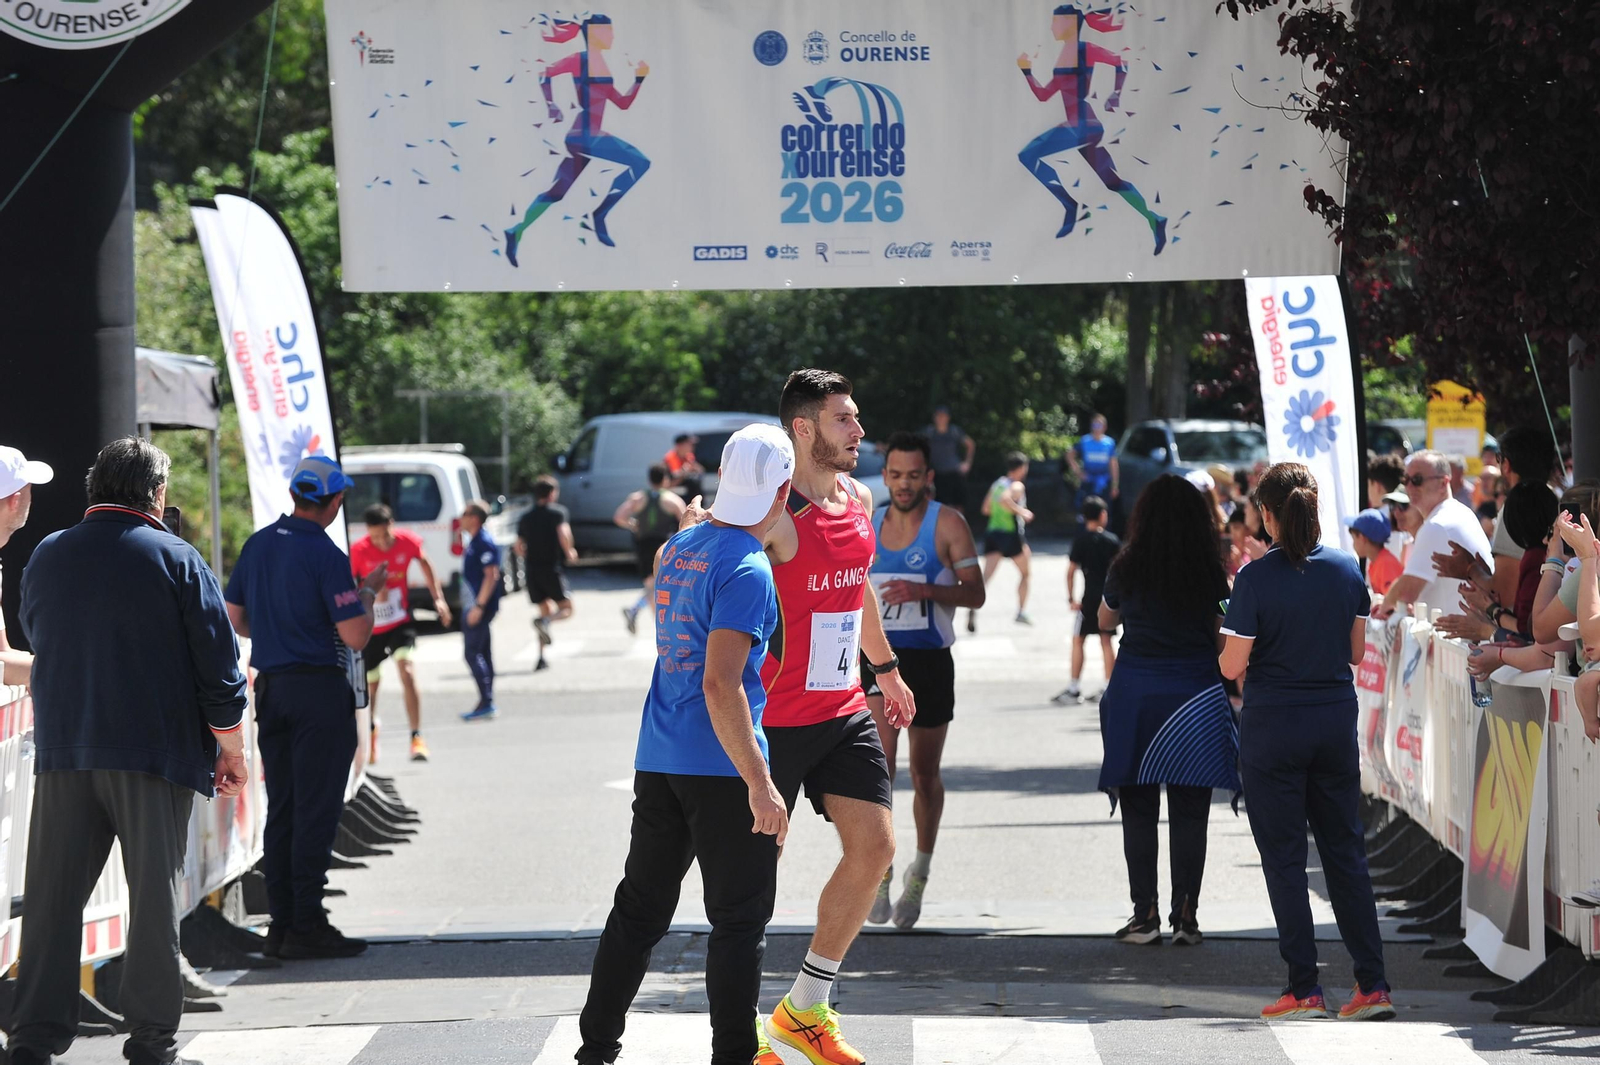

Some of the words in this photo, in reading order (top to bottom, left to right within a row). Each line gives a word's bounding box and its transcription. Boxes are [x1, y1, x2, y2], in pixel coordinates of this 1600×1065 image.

[15, 1, 141, 34] OURENSE
[839, 30, 897, 43] Concello
[900, 29, 917, 42] de
[840, 45, 931, 62] OURENSE
[781, 122, 906, 152] correndo
[780, 180, 905, 224] 2026
[695, 247, 746, 260] GADIS
[780, 243, 799, 255] chc
[950, 240, 993, 251] Apersa
[674, 557, 710, 573] OUENSE
[812, 572, 830, 592] LA
[837, 647, 849, 676] 4
